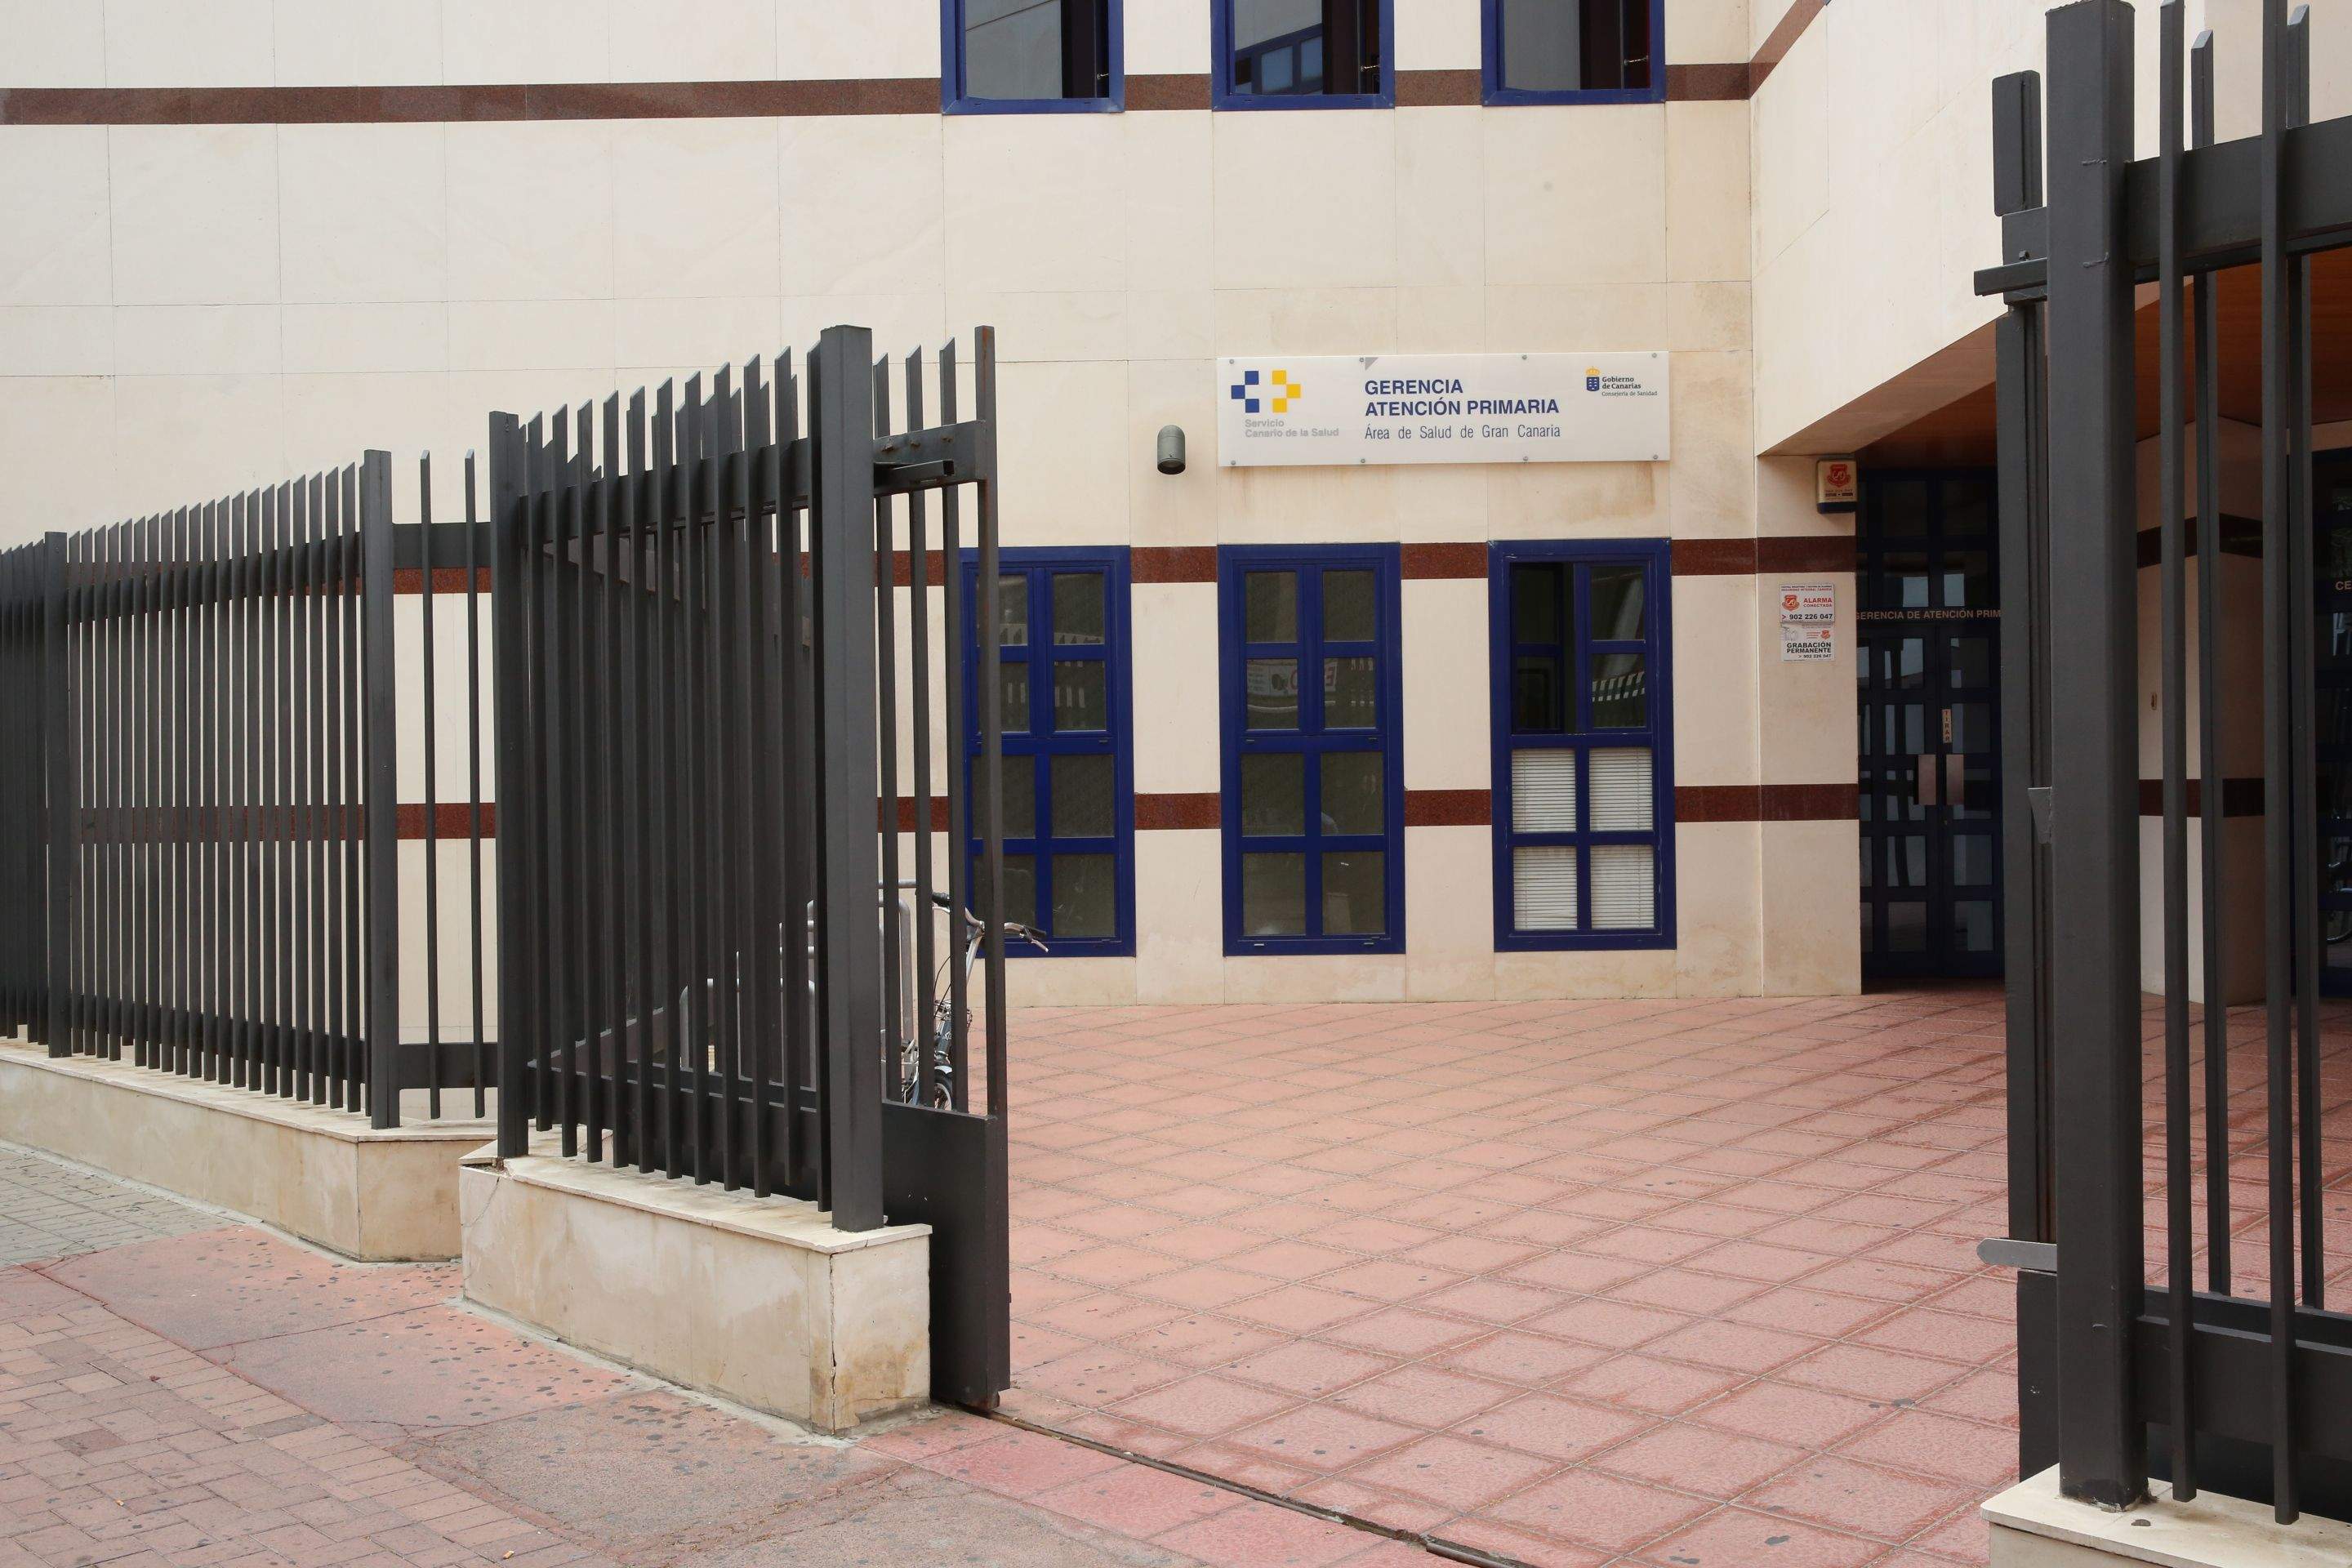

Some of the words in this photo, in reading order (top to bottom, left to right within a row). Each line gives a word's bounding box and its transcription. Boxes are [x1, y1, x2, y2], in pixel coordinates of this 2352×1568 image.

[1365, 379, 1463, 394] GERENCIA
[1365, 397, 1460, 416] ATENCIÓN
[1468, 399, 1560, 414] PRIMARIA
[1245, 419, 1285, 427] Servicio
[1245, 429, 1283, 438] Canario
[1285, 429, 1298, 437] de
[1300, 429, 1308, 437] la
[1312, 428, 1339, 437] Salud
[1365, 424, 1389, 439] Área
[1398, 426, 1411, 439] de
[1420, 425, 1451, 439] Salud
[1460, 425, 1474, 438] de
[1482, 424, 1508, 438] Gran
[1517, 424, 1561, 438] Canaria
[1907, 611, 1920, 619] DE
[1923, 608, 1973, 619] ATENCIÓN
